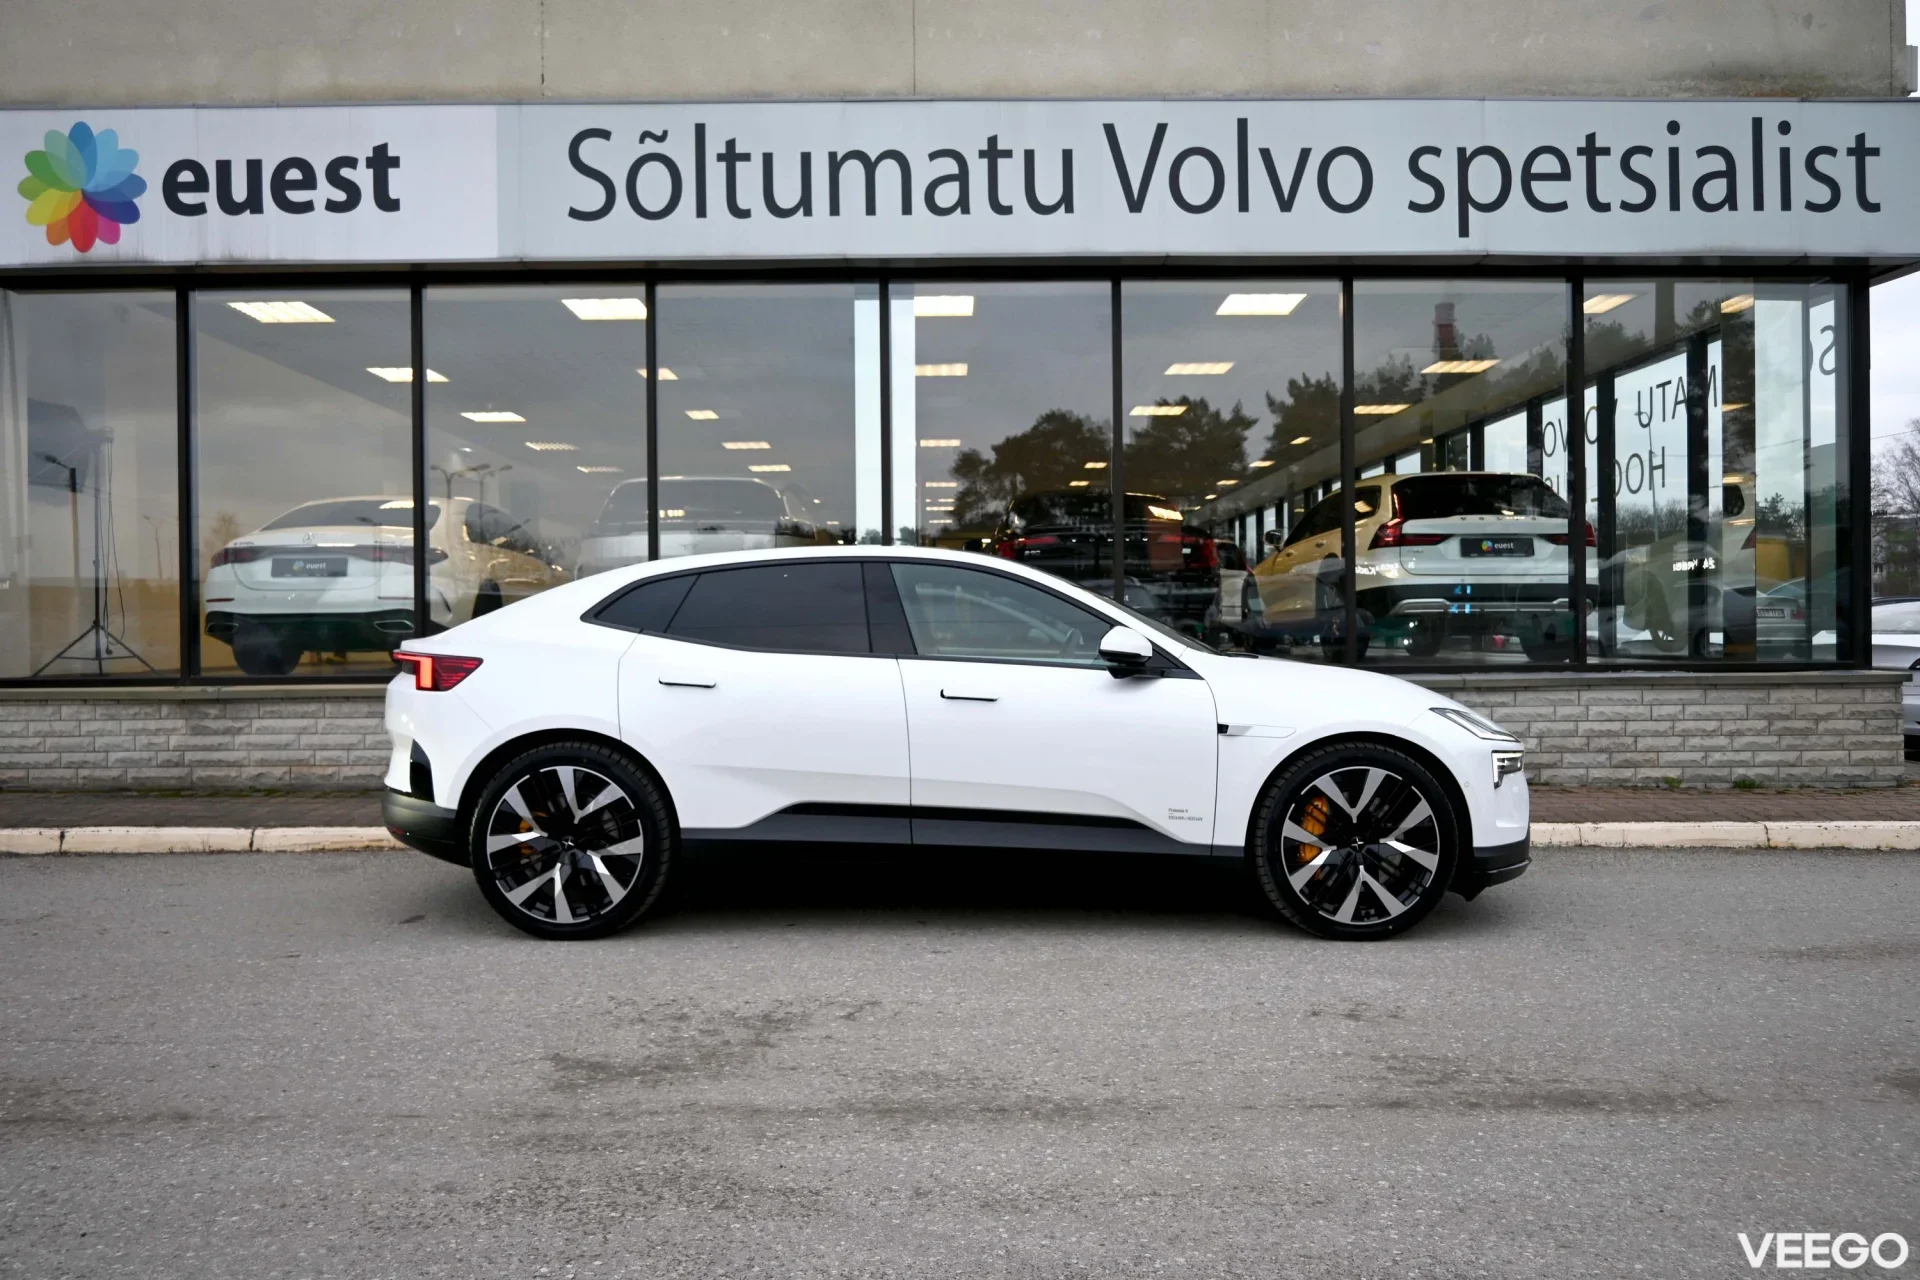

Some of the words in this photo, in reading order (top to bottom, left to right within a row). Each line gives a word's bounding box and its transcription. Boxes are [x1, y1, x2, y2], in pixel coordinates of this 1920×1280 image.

[162, 142, 401, 216] euest
[567, 121, 1074, 222] Sõltumatu
[1102, 117, 1375, 215] Volvo
[1406, 116, 1882, 239] spetsialist
